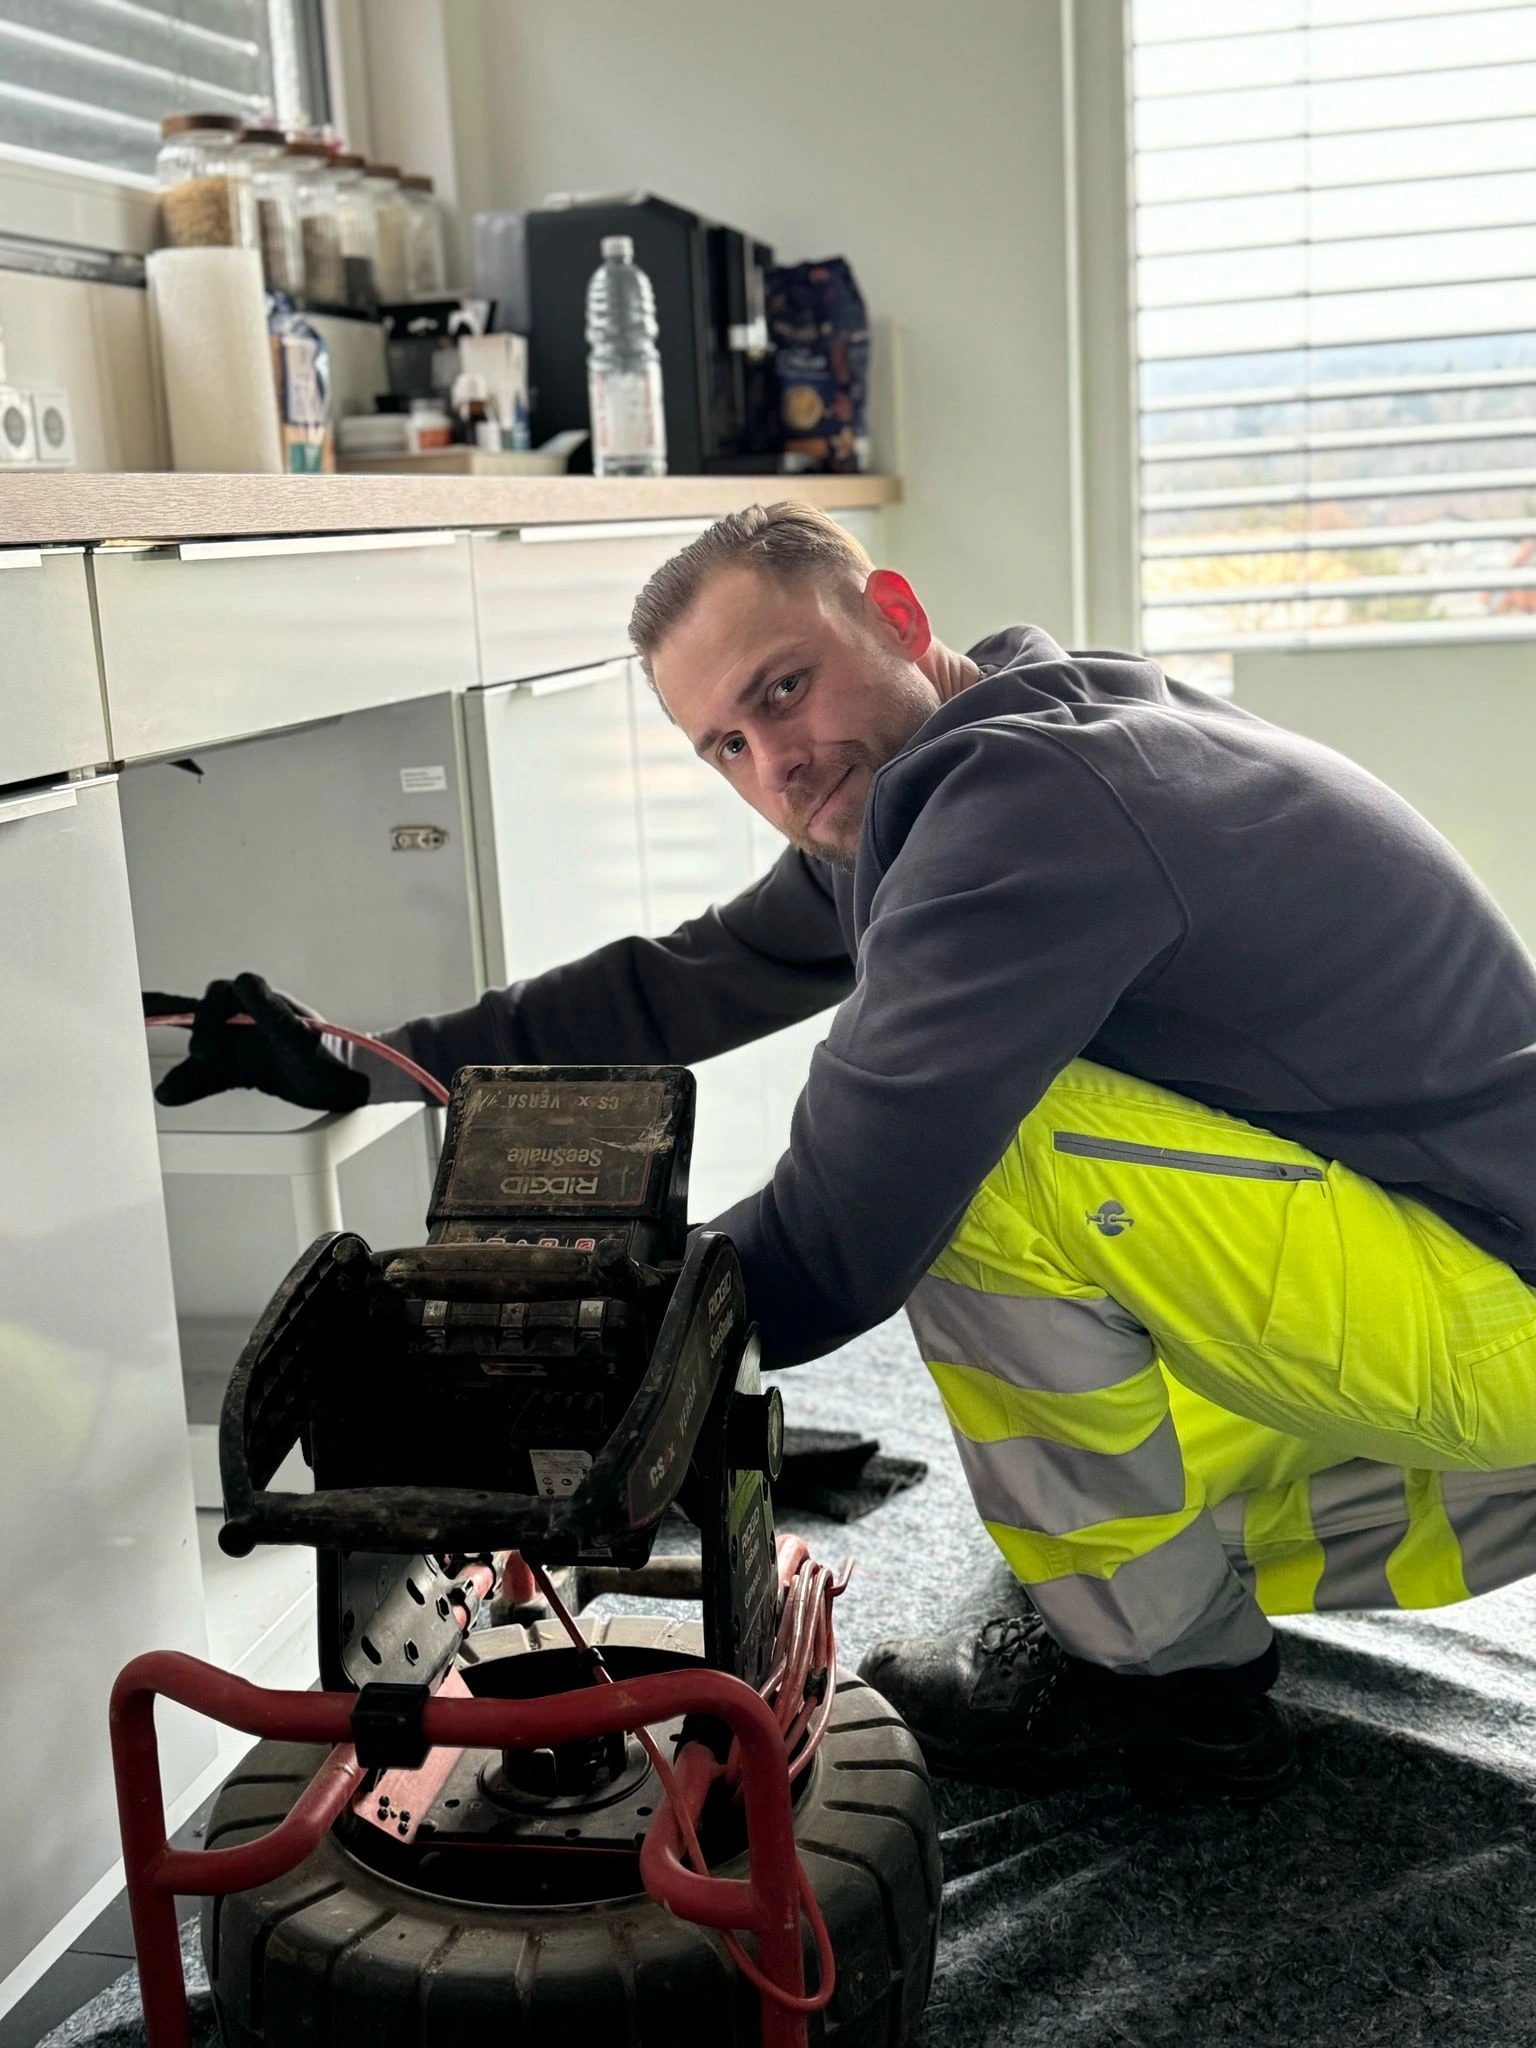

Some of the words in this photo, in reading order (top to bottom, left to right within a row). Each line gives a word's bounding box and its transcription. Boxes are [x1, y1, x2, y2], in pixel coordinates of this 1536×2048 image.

[507, 1093, 560, 1109] VERSA
[506, 1147, 603, 1167] SeeSnake
[500, 1176, 599, 1195] RIDGID
[708, 1270, 732, 1323] RIDGID
